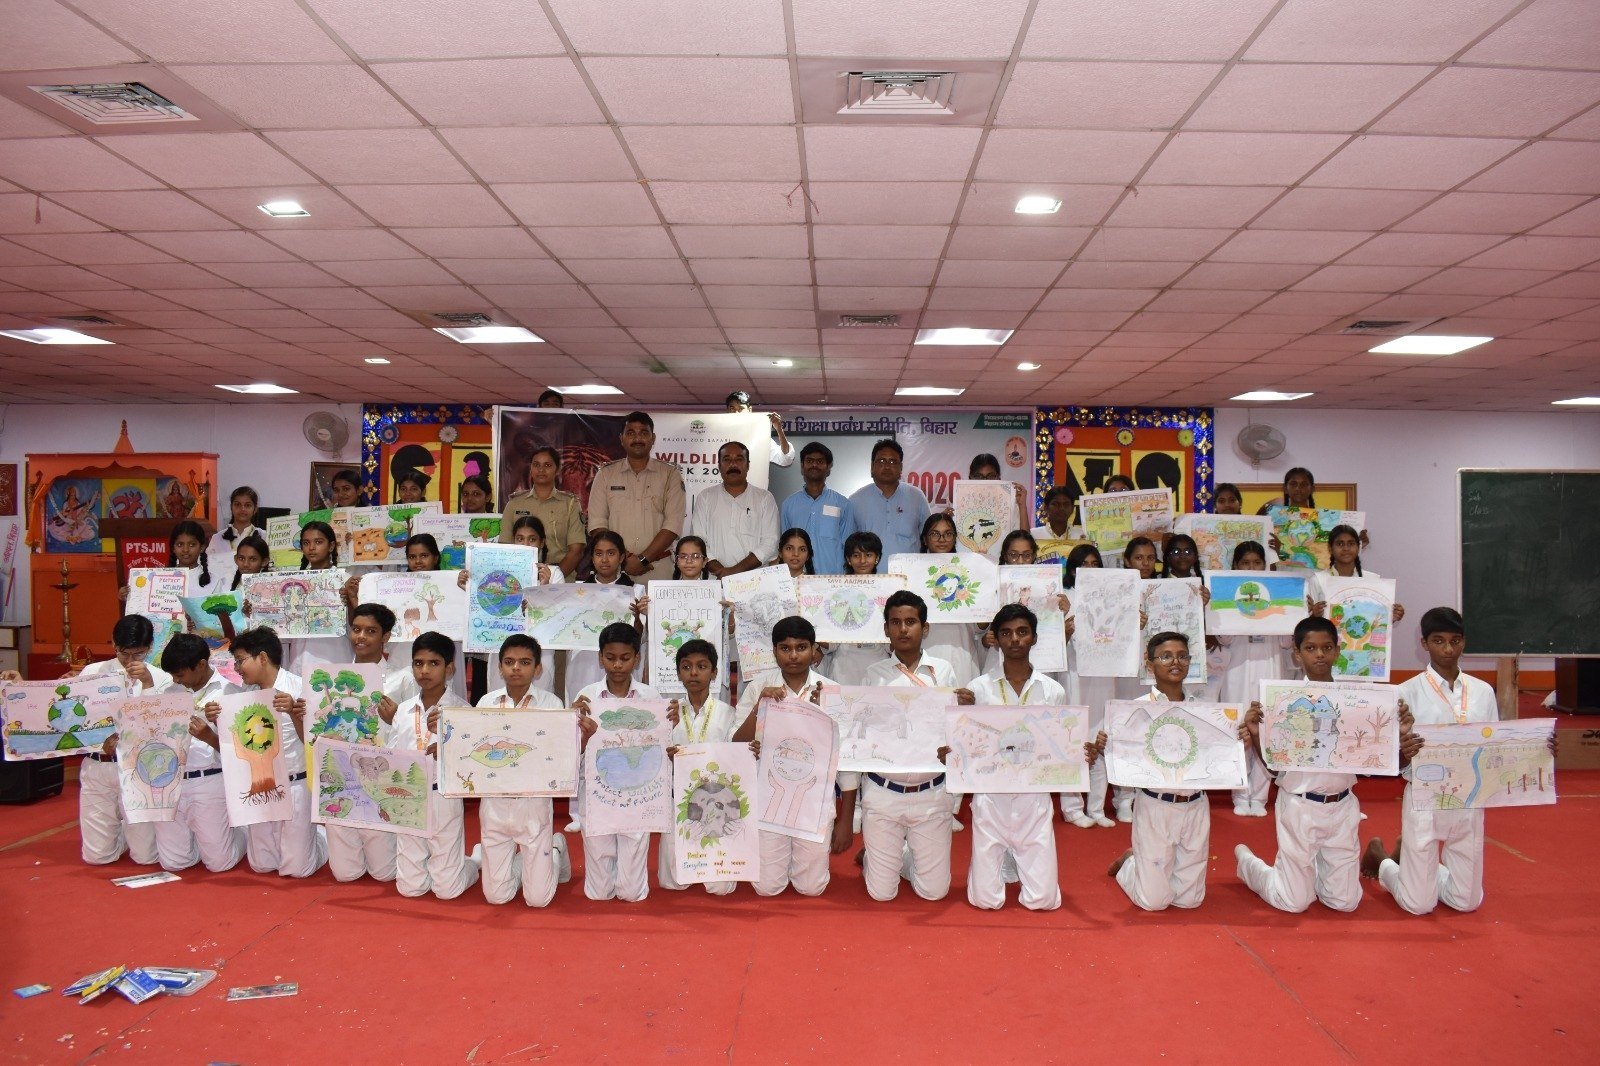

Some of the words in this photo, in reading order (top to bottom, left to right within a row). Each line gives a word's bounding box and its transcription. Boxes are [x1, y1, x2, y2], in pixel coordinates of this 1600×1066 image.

[794, 416, 829, 432] शिक्षा
[920, 416, 959, 435] बिहार
[655, 452, 716, 465] WILDLI
[702, 467, 719, 475] 20
[125, 542, 166, 554] PTSJM
[655, 588, 715, 600] CONSERVATION
[661, 608, 712, 620] WILDLIFE
